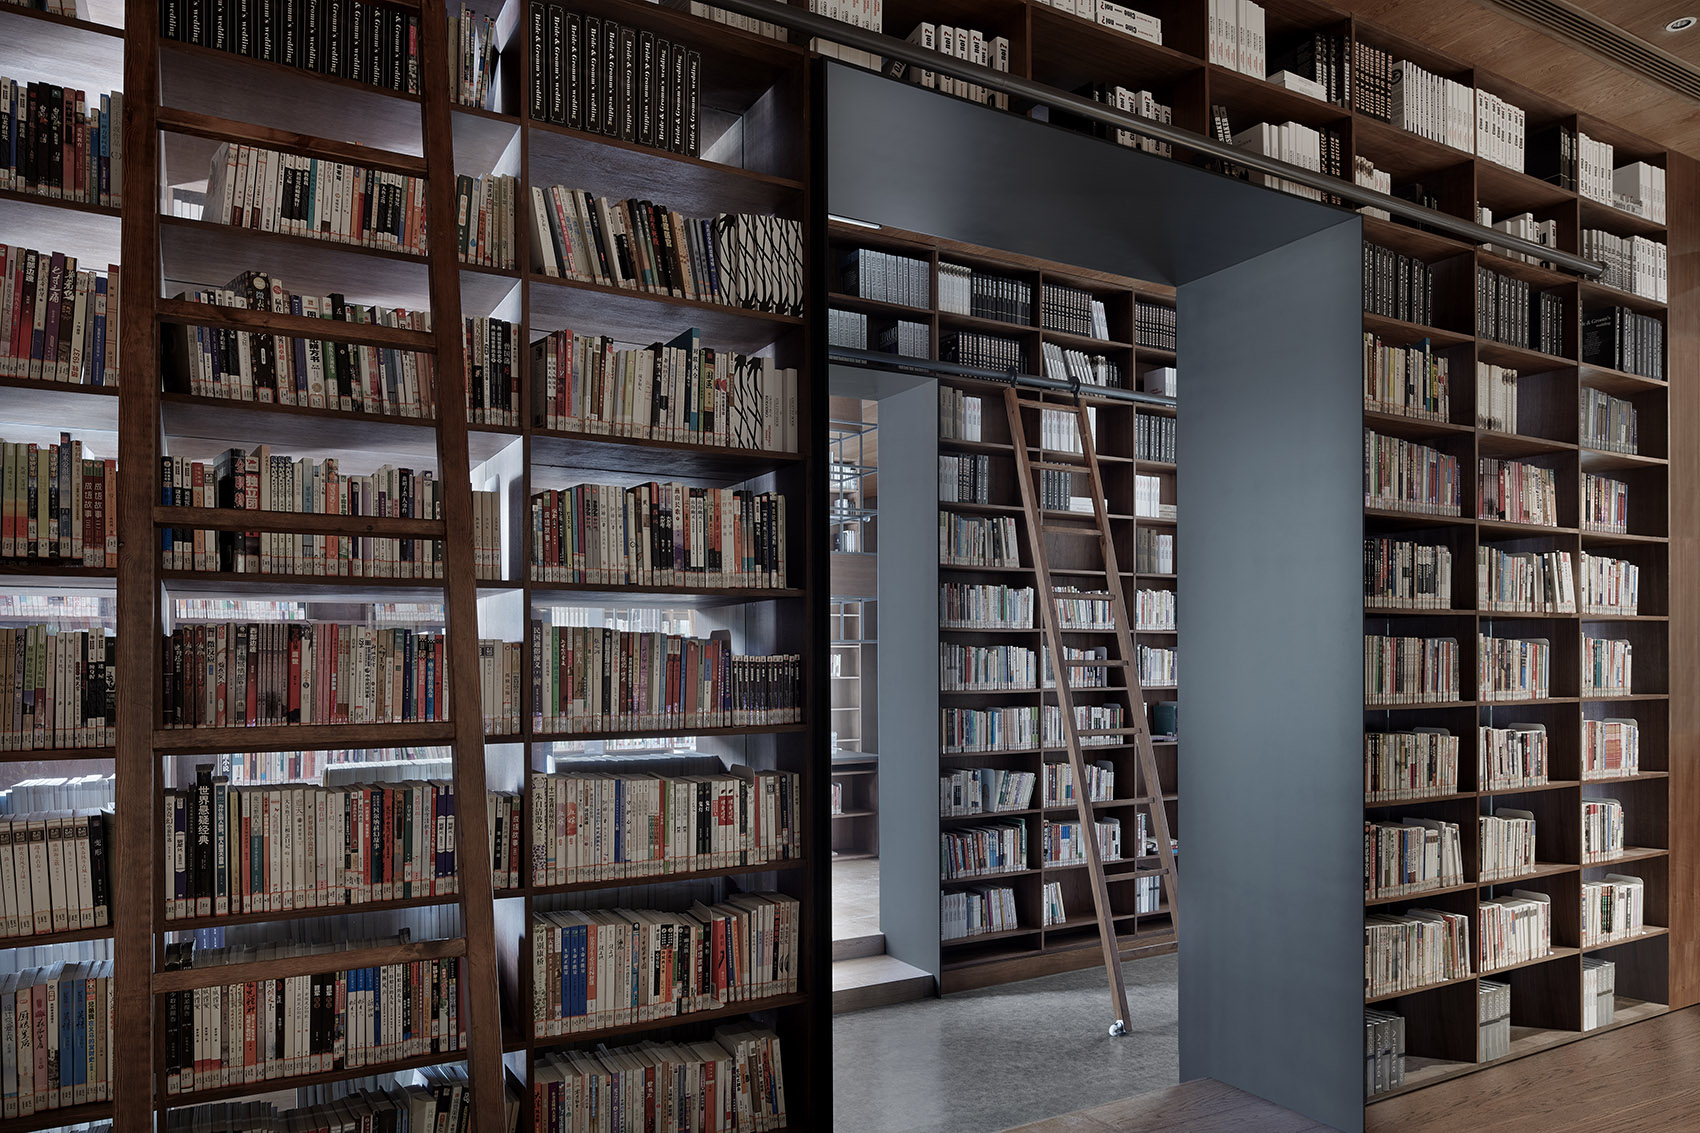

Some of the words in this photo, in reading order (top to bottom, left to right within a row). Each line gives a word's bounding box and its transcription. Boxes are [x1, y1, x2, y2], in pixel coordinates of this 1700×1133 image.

[198, 786, 209, 845] 世界悬疑经典
